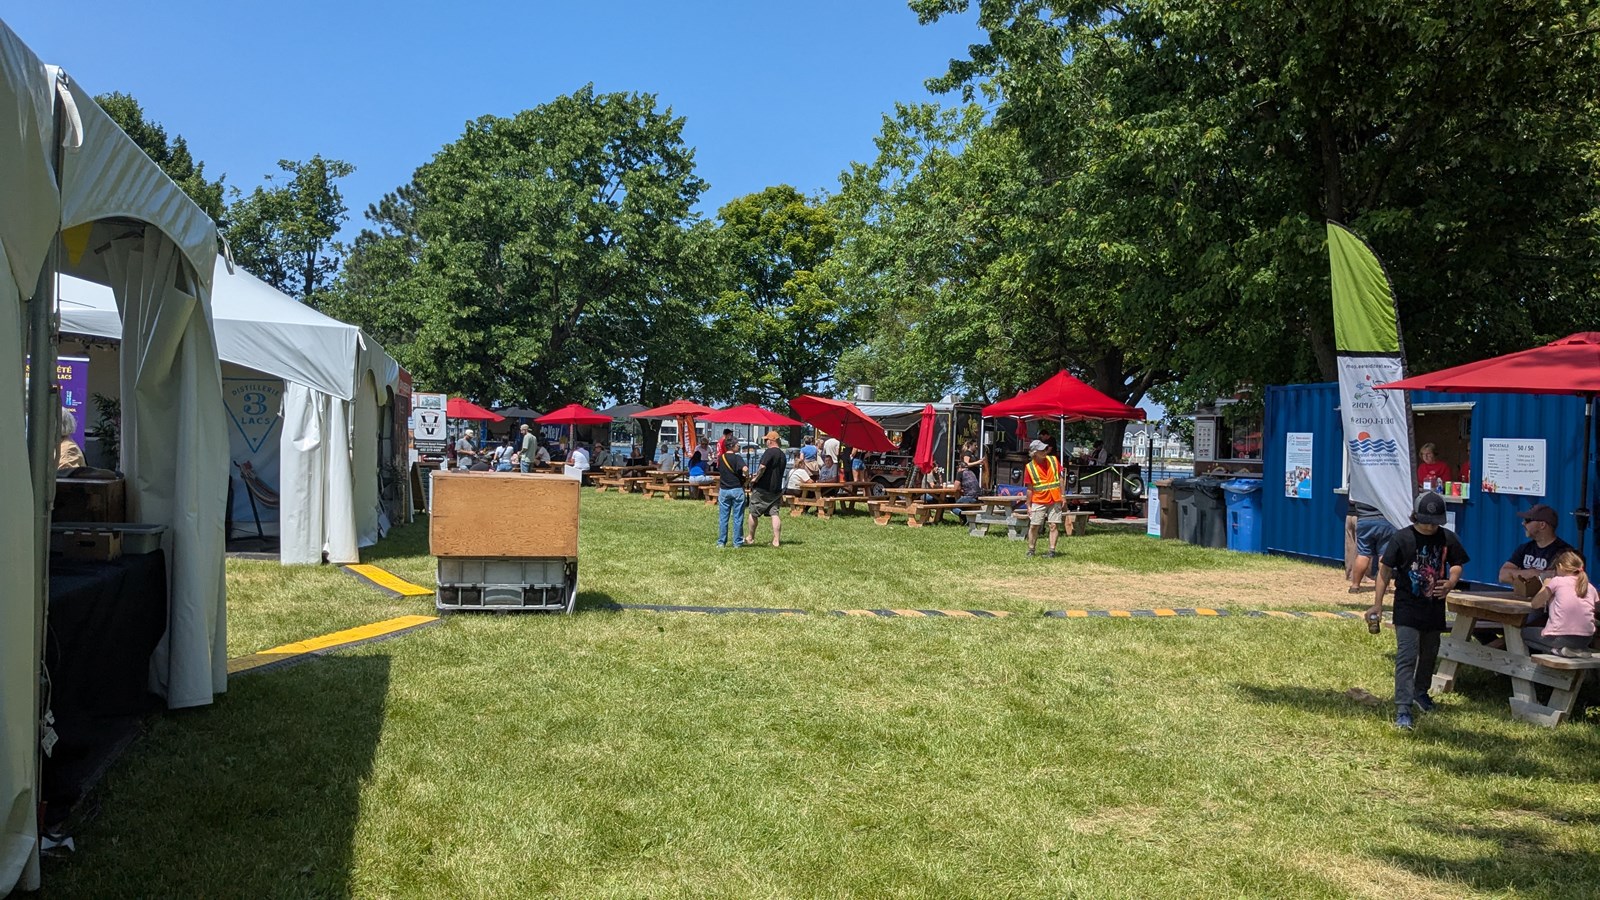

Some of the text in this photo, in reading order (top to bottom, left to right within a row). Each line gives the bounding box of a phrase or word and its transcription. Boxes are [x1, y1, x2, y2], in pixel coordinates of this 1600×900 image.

[231, 384, 280, 396] DISTILLERIE
[243, 392, 267, 415] 3
[241, 417, 271, 425] LACS
